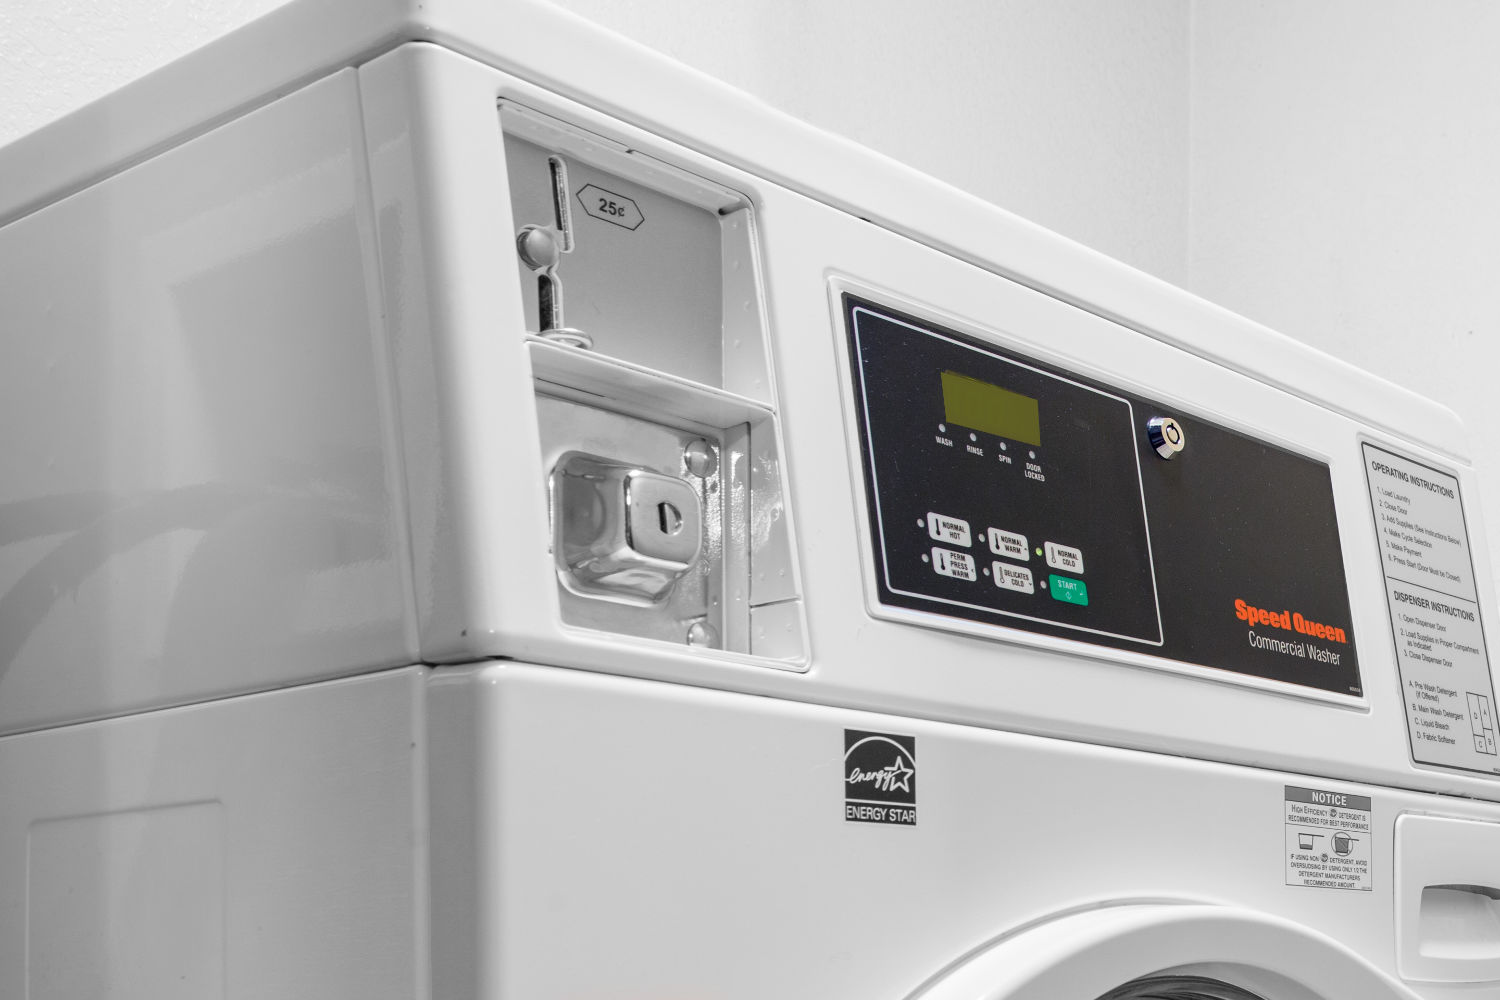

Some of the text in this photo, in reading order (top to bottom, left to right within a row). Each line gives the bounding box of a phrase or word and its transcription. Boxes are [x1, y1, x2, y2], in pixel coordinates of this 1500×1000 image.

[599, 198, 625, 217] 25¢
[936, 436, 953, 447] WASH
[967, 445, 984, 456] RINSE
[999, 454, 1012, 464] SPIN
[1026, 462, 1042, 473] DOOR
[1024, 470, 1045, 482] LOCKED
[1372, 461, 1454, 500] OPERATING INSTRUCTIONS
[1382, 488, 1393, 498] Load
[1394, 492, 1410, 505] Laundry
[1384, 501, 1396, 512] Close
[1397, 506, 1408, 515] Door
[942, 522, 966, 534] NORMAL
[1386, 515, 1396, 524] Add
[1396, 518, 1414, 530] Supplies
[950, 531, 960, 540] HOT
[1001, 536, 1022, 546] NORMAL
[1389, 528, 1400, 538] Make
[1401, 532, 1413, 542] Cycle
[1414, 536, 1432, 548] Selection
[1005, 545, 1021, 554] WARM
[1391, 542, 1403, 552] Make
[950, 552, 966, 562] PERM
[1058, 550, 1078, 560] NORMAL
[950, 561, 968, 570] PRESS
[1063, 559, 1076, 568] COLD
[1393, 555, 1406, 566] Press
[1406, 560, 1416, 569] Start
[952, 570, 970, 579] WARM
[1004, 569, 1029, 580] DELICATES
[1012, 578, 1024, 588] COLD
[1058, 580, 1078, 591] START
[1394, 590, 1474, 622] DISPENSER INSTRUCTIONS
[1234, 598, 1346, 644] Speed Queen
[1403, 614, 1414, 624] Open
[1415, 618, 1436, 630] Dispenser
[1436, 623, 1446, 632] Door
[1406, 630, 1416, 639] Load
[1416, 632, 1434, 644] Supplies
[1440, 638, 1453, 648] Proper
[1248, 630, 1341, 666] Commercial Washer
[1409, 650, 1421, 660] Close
[1422, 654, 1442, 665] Dispenser
[1443, 658, 1452, 668] Door
[1414, 681, 1423, 690] Pre
[1424, 684, 1436, 693] Wash
[1436, 686, 1457, 698] Detergent
[1418, 704, 1429, 713] Main
[1430, 707, 1442, 716] Wash
[1442, 709, 1464, 720] Detergent
[1420, 718, 1434, 728] Liquid
[1434, 721, 1450, 730] Bleach
[1423, 732, 1436, 742] Fabric
[1438, 735, 1456, 744] Softener
[849, 767, 893, 791] energy
[1312, 792, 1347, 806] NOTICE
[847, 806, 916, 822] ENERGY STAR
[1339, 812, 1361, 820] DETERGENT
[1288, 814, 1320, 825] RECOMMENDED
[1330, 819, 1340, 827] BEST
[1290, 862, 1320, 870] OVERSUDSING
[1304, 879, 1336, 887] RECOMMENDED
